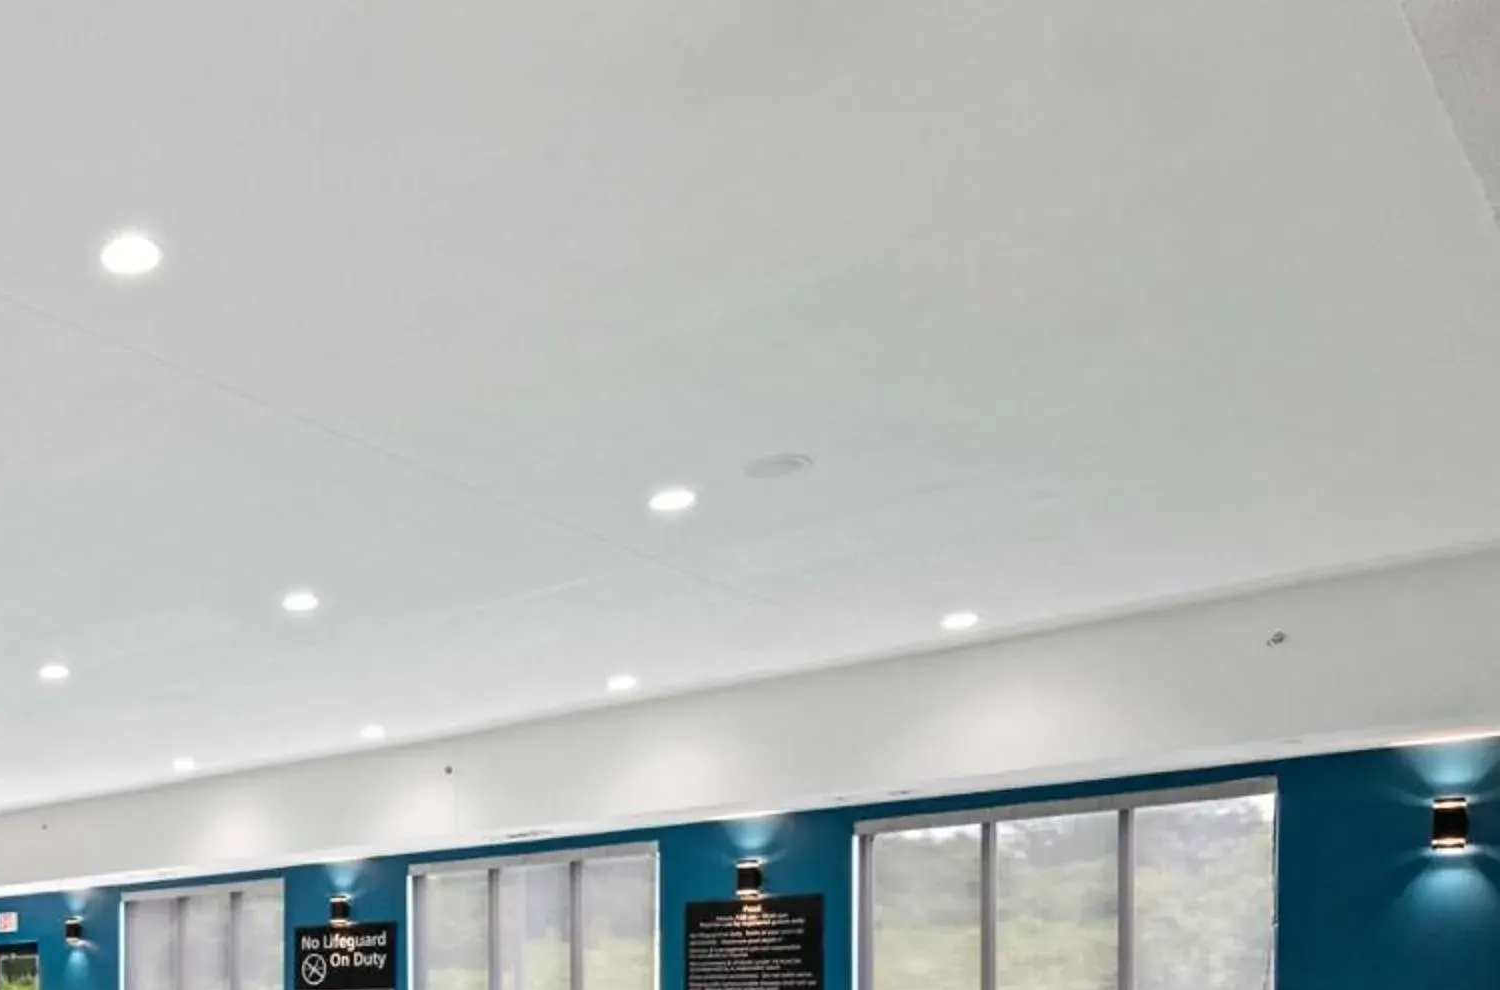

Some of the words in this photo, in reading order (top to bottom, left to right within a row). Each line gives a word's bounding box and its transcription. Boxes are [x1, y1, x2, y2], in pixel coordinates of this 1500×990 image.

[301, 935, 321, 951] No
[323, 930, 387, 951] Lifeguard
[330, 951, 350, 968] On
[353, 951, 388, 970] Duty
